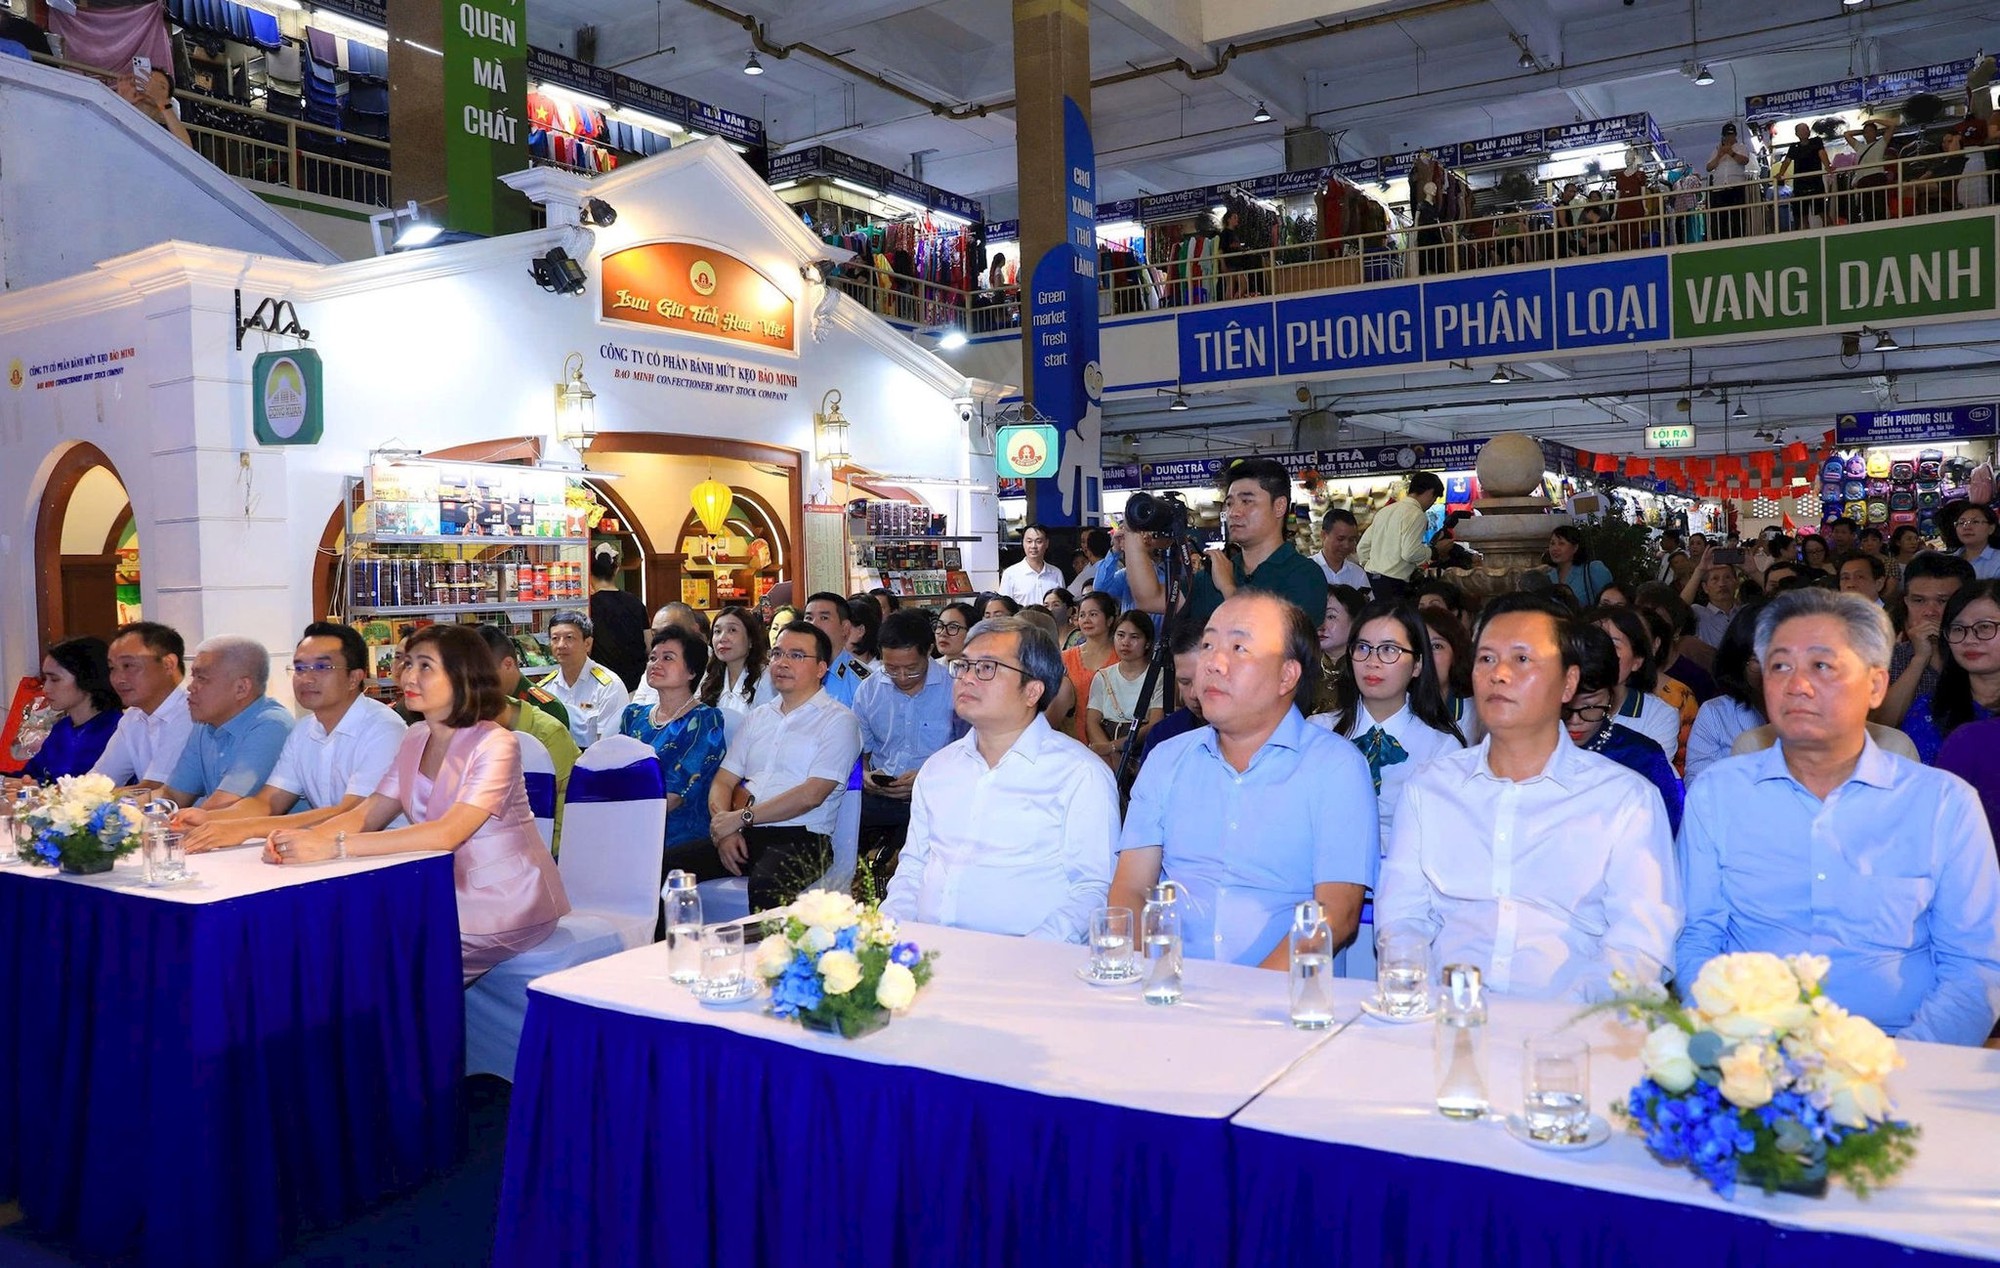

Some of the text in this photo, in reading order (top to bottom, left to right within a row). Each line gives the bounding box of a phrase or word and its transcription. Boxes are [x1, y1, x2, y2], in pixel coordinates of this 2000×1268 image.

[459, 3, 517, 47] QUEN
[537, 52, 568, 71] QUANG
[473, 55, 507, 93] MÀ
[1766, 89, 1811, 105] PHƯƠNG
[1814, 85, 1837, 98] HOA
[463, 107, 518, 145] CHẤT
[724, 113, 745, 128] VÂN
[1560, 118, 1627, 137] LAN ANH
[1475, 140, 1497, 151] LAN
[1499, 136, 1522, 147] ANH
[1073, 167, 1091, 192] CHỢ
[1072, 195, 1094, 220] XANH
[1150, 194, 1174, 206] DUNG
[1074, 253, 1095, 279] LÀNH
[1038, 289, 1066, 304] Green
[1033, 310, 1066, 326] market
[1194, 246, 1981, 373] TIÊN PHONG PHÂN LOẠI VANG DANH
[1042, 331, 1067, 347] fresh
[600, 342, 628, 362] CÔNG
[631, 349, 645, 364] TY
[738, 366, 757, 384] KẸO
[758, 367, 774, 385] BẢO
[776, 372, 798, 388] MINH
[1044, 351, 1068, 368] start
[29, 364, 42, 377] CÔNG
[42, 363, 49, 374] TY
[614, 369, 789, 401] BAO MINH CONFECTIONERY JOINT STOCK COMPANY
[1895, 413, 1931, 426] PHƯƠNG
[1933, 411, 1953, 423] SILK
[1673, 429, 1688, 438] RA
[1430, 443, 1470, 457] THÀNH
[1339, 460, 1378, 470] TRANG
